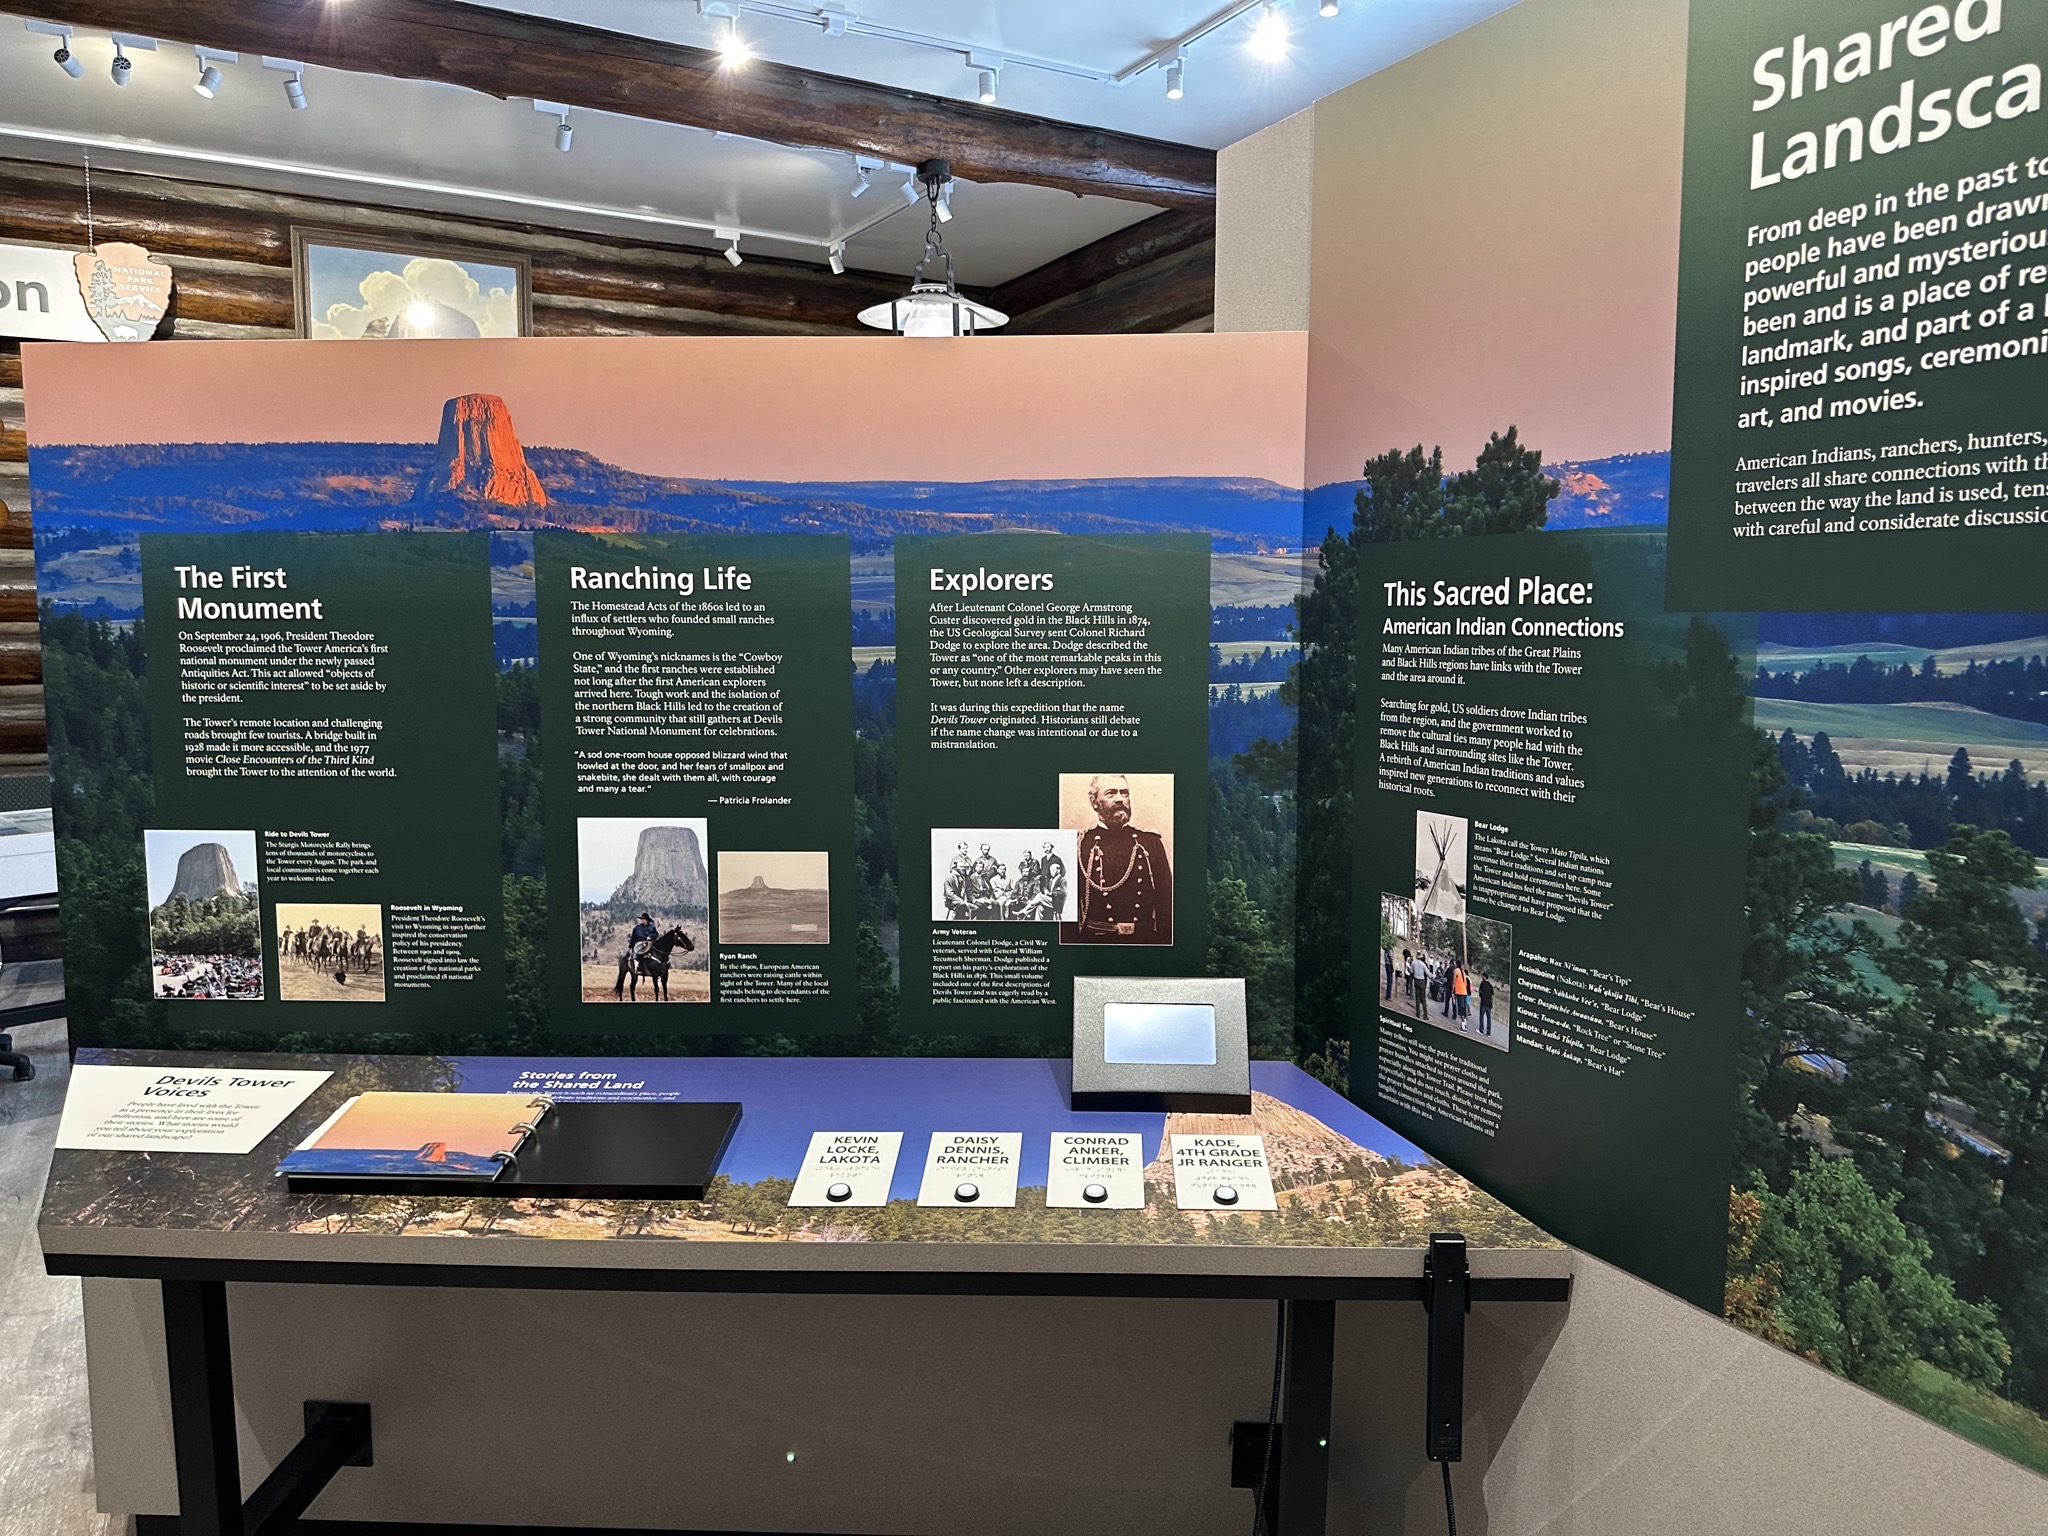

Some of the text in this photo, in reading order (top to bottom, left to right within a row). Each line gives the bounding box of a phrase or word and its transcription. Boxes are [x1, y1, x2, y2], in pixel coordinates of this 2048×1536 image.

[1752, 0, 2002, 111] Shared
[1748, 220, 1801, 247] From
[1808, 203, 1867, 231] deep
[1875, 196, 1897, 216] in
[1905, 182, 1949, 208] the
[1957, 162, 2018, 202] past
[1745, 243, 1820, 282] people
[1827, 231, 1886, 259] have
[1893, 214, 1957, 244] been
[113, 265, 167, 278] NATIONAL
[1744, 229, 2047, 312] powerful and mysteriou
[126, 275, 155, 286] PARK
[119, 283, 162, 294] SERVICE
[1743, 313, 1796, 336] been
[1803, 296, 1847, 325] and
[1854, 298, 1873, 316] is
[1880, 294, 1894, 311] a
[1902, 279, 1971, 313] place
[1979, 268, 2010, 293] of
[1742, 329, 1853, 366] landmark,
[1860, 317, 1908, 347] and
[1915, 310, 1971, 343] part
[1979, 299, 2010, 327] of
[2017, 303, 2034, 321] a
[1741, 362, 1828, 396] inspired
[1834, 357, 1912, 382] songs,
[1738, 391, 1923, 428] art, and movies.
[1735, 431, 2048, 471] American Indians, ranchers, hunters,
[1736, 454, 2028, 493] travelers all share connections with
[512, 0, 645, 1089] the Shared Land
[174, 565, 287, 588] The First
[571, 566, 751, 596] Ranching Life
[931, 567, 1053, 596] Explorers
[1384, 576, 1593, 606] This Sacred Place:
[178, 597, 323, 619] Monument
[570, 601, 590, 610] The
[592, 601, 645, 611] Homestead
[647, 602, 667, 611] Acts
[669, 601, 680, 611] of
[681, 602, 696, 611] the
[699, 602, 724, 611] 1860s
[725, 602, 740, 611] led
[742, 603, 752, 611] to
[929, 602, 1133, 614] After Lieutenant Colonel George Armstrong
[929, 615, 1150, 627] Custer discovered gold in the Black Hills in 1874,
[1383, 616, 1624, 637] American Indian Connections
[178, 631, 374, 643] On September 24, 1906, President Theodore
[179, 643, 223, 653] Roosevelt
[225, 643, 276, 655] proclaimed
[278, 643, 293, 653] the
[293, 644, 323, 653] Tower
[370, 643, 388, 653] first
[1382, 643, 1581, 659] Many American Indian tribes of the Great Plains
[719, 796, 792, 804] Patricia Frolander
[1475, 820, 1509, 834] Bear Lodge
[278, 841, 299, 849] Sturgis
[300, 841, 334, 849] Motorcycle
[335, 842, 350, 850] Rally
[351, 842, 371, 850] brings
[431, 905, 463, 913] Wyoming
[1518, 949, 1549, 964] Arapaho:
[1518, 963, 1588, 990] Assiniboine (Nakota):
[1517, 977, 1552, 994] Cheyenne:
[1517, 991, 1537, 1004] Crow:
[1516, 1005, 1540, 1020] Kiowa:
[1516, 1020, 1541, 1034] Lakota:
[1516, 1034, 1545, 1050] Mandan:
[519, 1071, 617, 1079] Stories from
[155, 1076, 295, 1088] Devils Tower
[144, 1087, 210, 1097] Voices
[834, 1136, 878, 1144] KEVIN
[954, 1136, 999, 1144] DAISY
[1064, 1137, 1129, 1145] CONRAD
[1194, 1139, 1240, 1148] KADE,
[827, 1146, 879, 1154] LOCKE,
[944, 1146, 1004, 1155] DENNIS,
[1069, 1147, 1123, 1156] ANKER,
[1209, 1149, 1261, 1157] GRADE
[937, 1156, 1009, 1164] RANCHER
[1063, 1156, 1129, 1165] CLIMBER
[1199, 1159, 1263, 1167] RANGER
